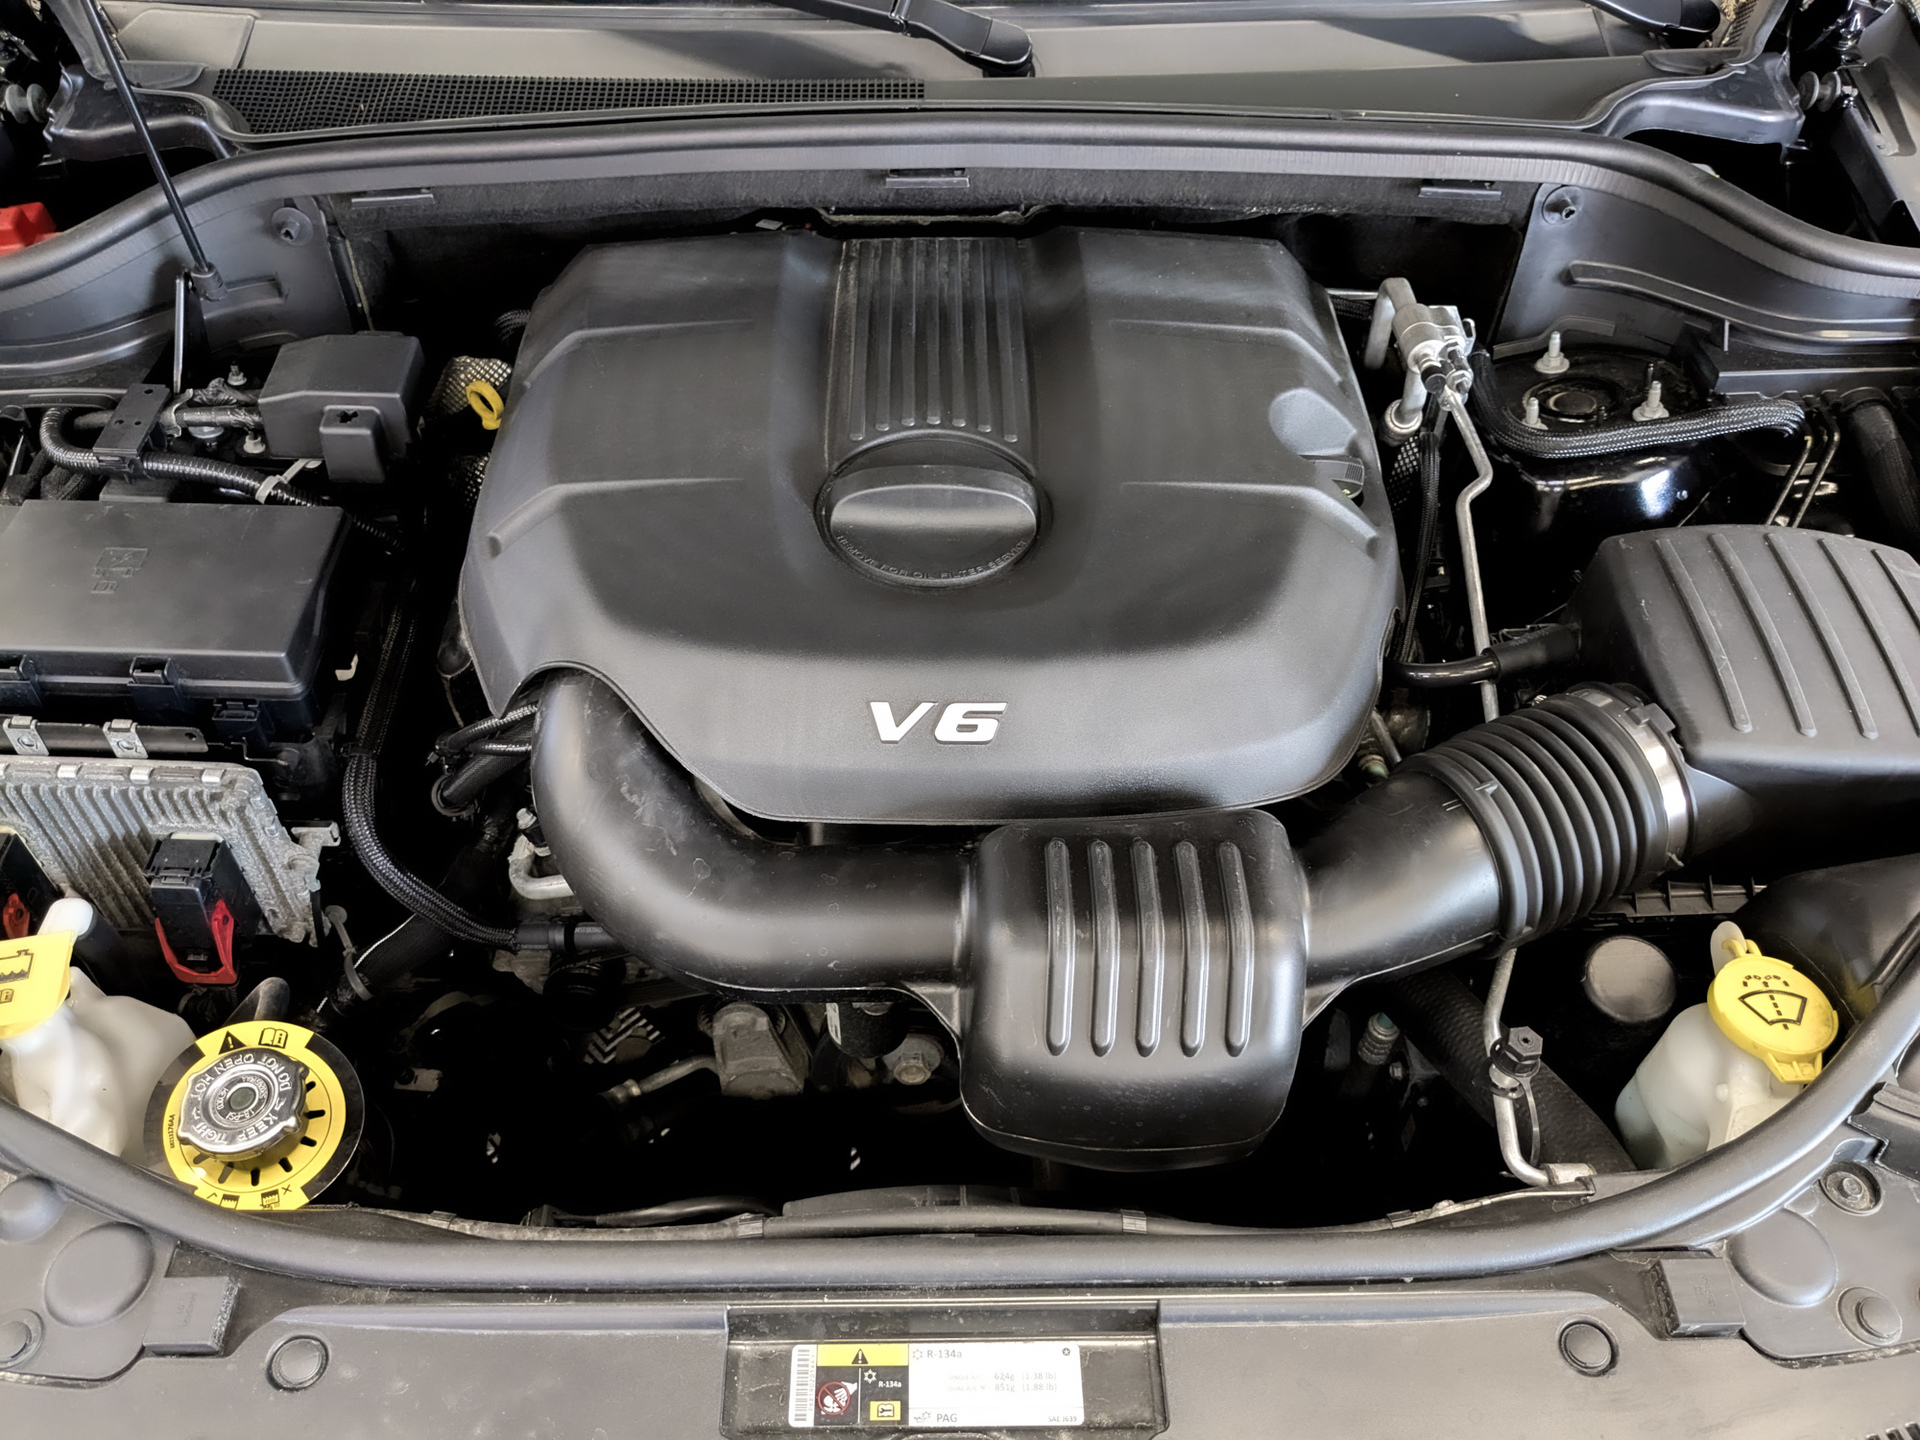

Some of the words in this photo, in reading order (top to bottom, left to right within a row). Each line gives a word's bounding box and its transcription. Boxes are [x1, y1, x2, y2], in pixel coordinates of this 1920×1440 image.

[881, 564, 908, 577] FOR
[913, 571, 935, 580] OIL
[941, 565, 985, 580] FILTER
[869, 701, 1008, 745] V6
[214, 1053, 255, 1075] OPEN
[257, 1055, 285, 1074] NOT
[191, 1073, 215, 1100] HOT
[191, 1121, 228, 1144] TIGHT
[238, 1113, 278, 1141] KEEP
[927, 1349, 963, 1359] R-134a
[878, 1380, 902, 1388] R-134a
[994, 1372, 1015, 1382] 624g
[1021, 1372, 1044, 1382] (1.38
[1045, 1372, 1057, 1382] lb)
[994, 1383, 1016, 1393] 851g
[1022, 1382, 1044, 1392] (1.88
[1045, 1382, 1058, 1392] lb)
[936, 1413, 958, 1423] PAG
[1048, 1415, 1060, 1423] SAE
[1062, 1415, 1078, 1423] J639
